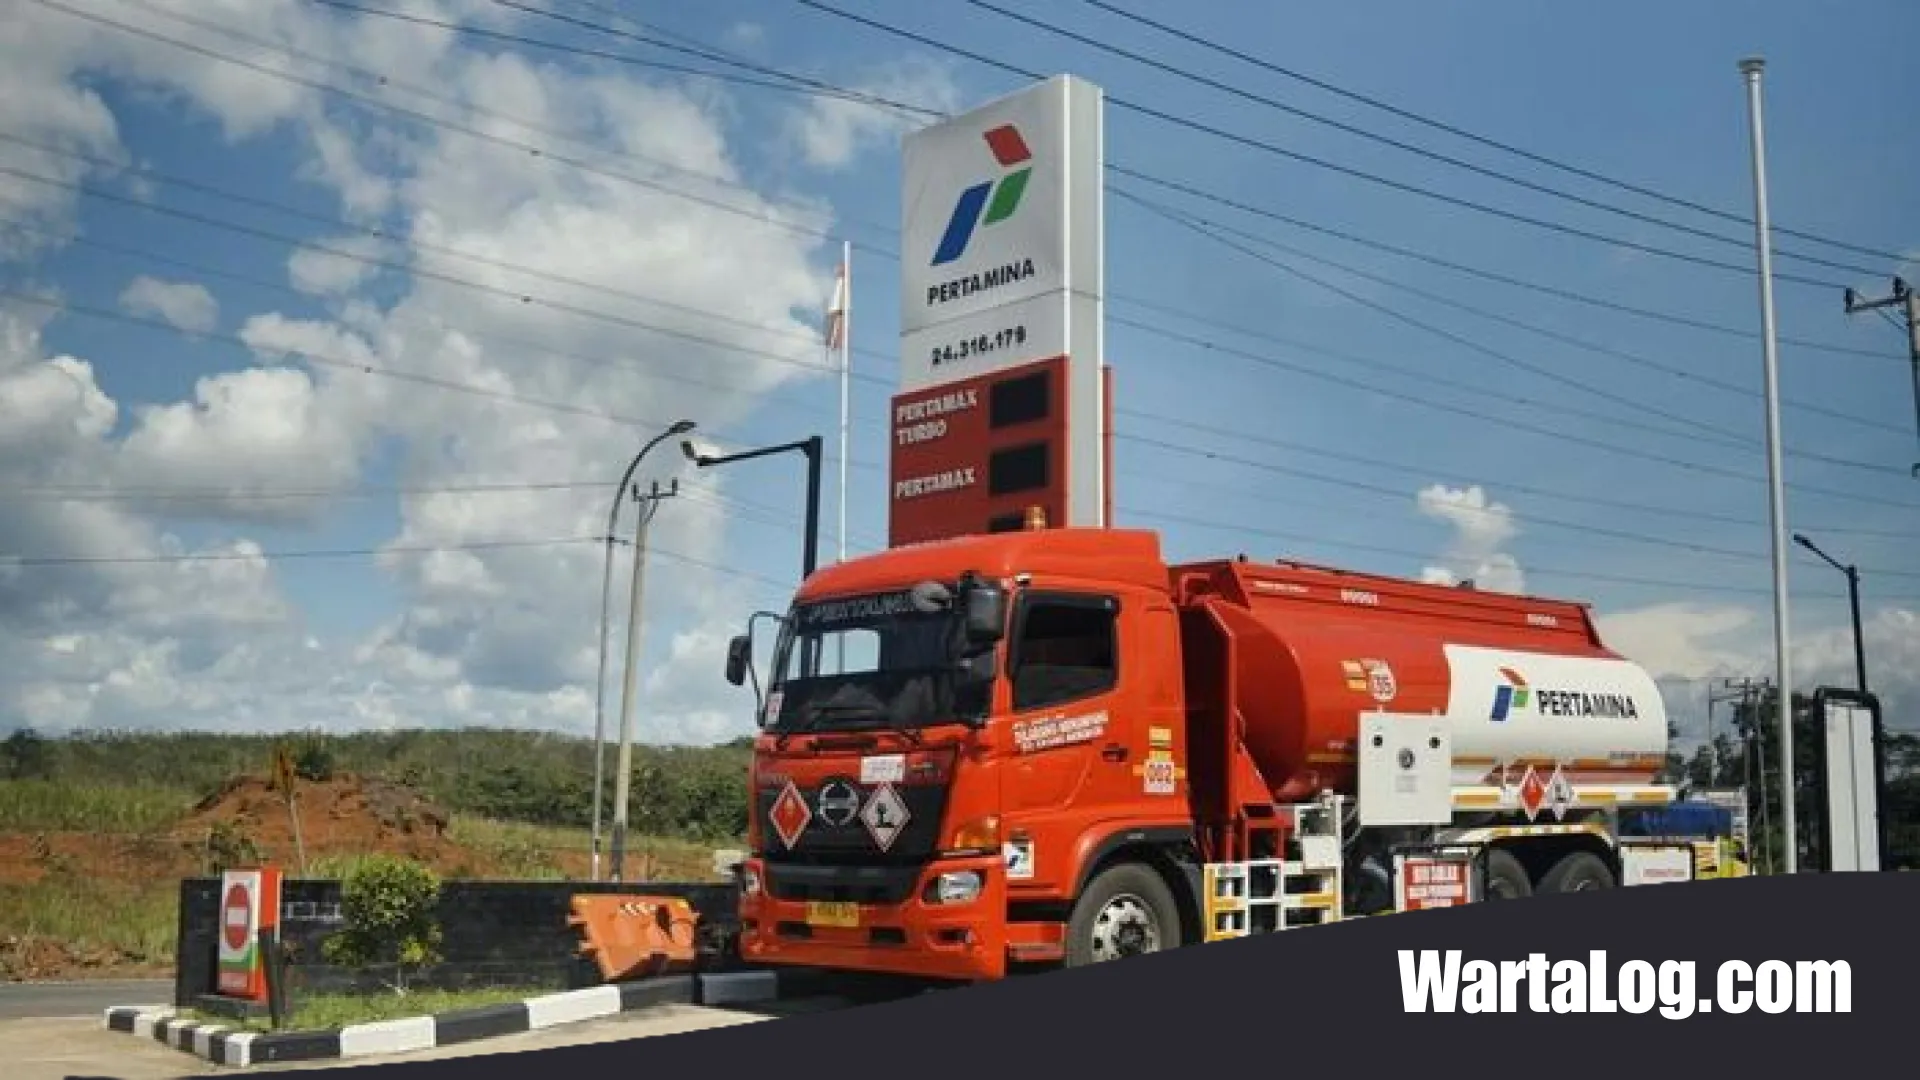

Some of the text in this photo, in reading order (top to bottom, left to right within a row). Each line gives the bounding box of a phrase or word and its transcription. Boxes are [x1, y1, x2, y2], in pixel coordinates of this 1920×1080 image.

[926, 257, 1035, 306] PERTAMINA
[896, 388, 977, 423] PERTAMAX
[896, 419, 947, 445] TURBO
[895, 467, 975, 500] PERTAMAX
[1535, 689, 1638, 720] PERTAMINA
